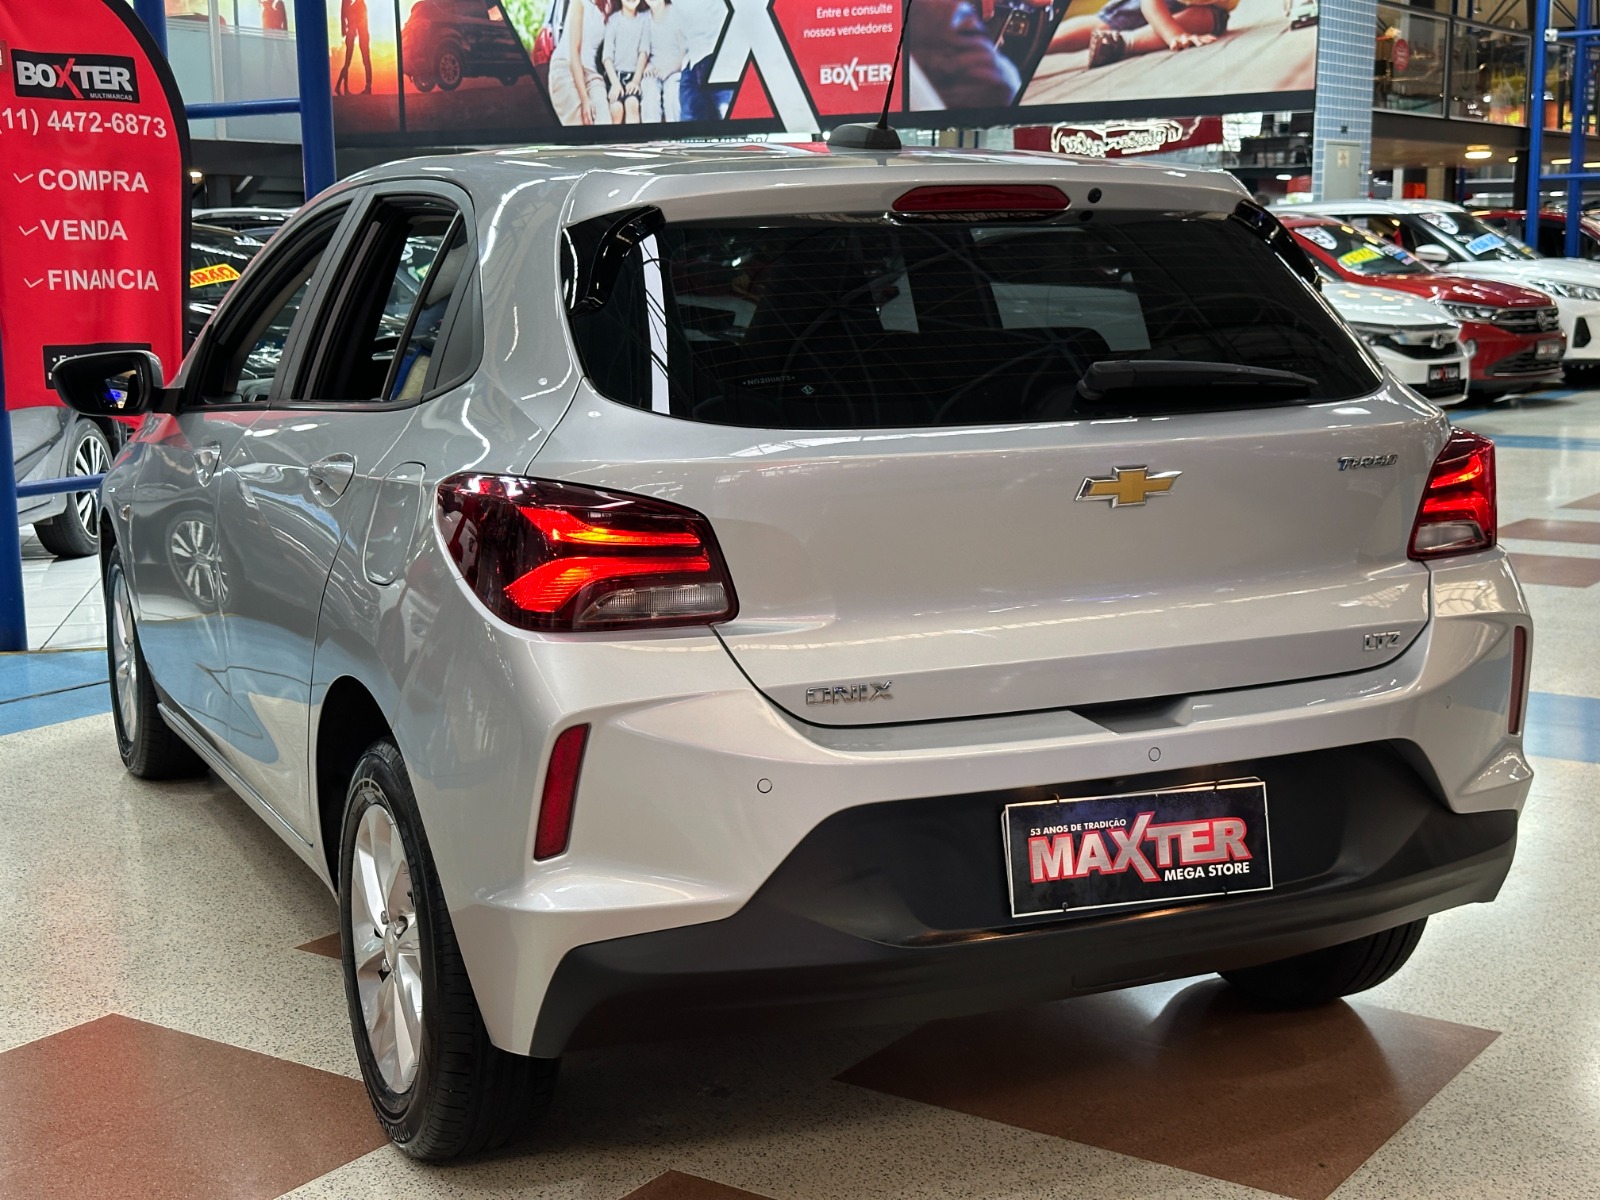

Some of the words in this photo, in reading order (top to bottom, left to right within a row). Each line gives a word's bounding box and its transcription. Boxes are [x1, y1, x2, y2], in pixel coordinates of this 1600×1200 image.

[816, 7, 841, 19] Entre
[843, 8, 850, 17] e
[851, 3, 893, 16] consulte
[803, 27, 836, 38] nossos
[837, 23, 893, 36] vendedores
[16, 58, 134, 99] BOXTER
[820, 56, 893, 91] BOXTER
[90, 92, 133, 101] MULTIMARCAS
[0, 107, 39, 136] 11)
[47, 110, 167, 138] 4472-6873
[38, 169, 149, 193] COMPRA
[40, 219, 128, 241] VENDA
[47, 268, 159, 291] FINANCIA
[1337, 453, 1398, 471] TURBO
[1363, 630, 1400, 651] LTZ
[806, 680, 893, 705] ONIX
[1030, 828, 1041, 836] 53
[1043, 824, 1069, 835] ANOS
[1070, 823, 1082, 832] DE
[1083, 818, 1127, 830] TRADIÇÃO
[1028, 811, 1253, 883] MAXTER
[1164, 866, 1206, 882] MEGA
[1208, 862, 1250, 877] STORE
